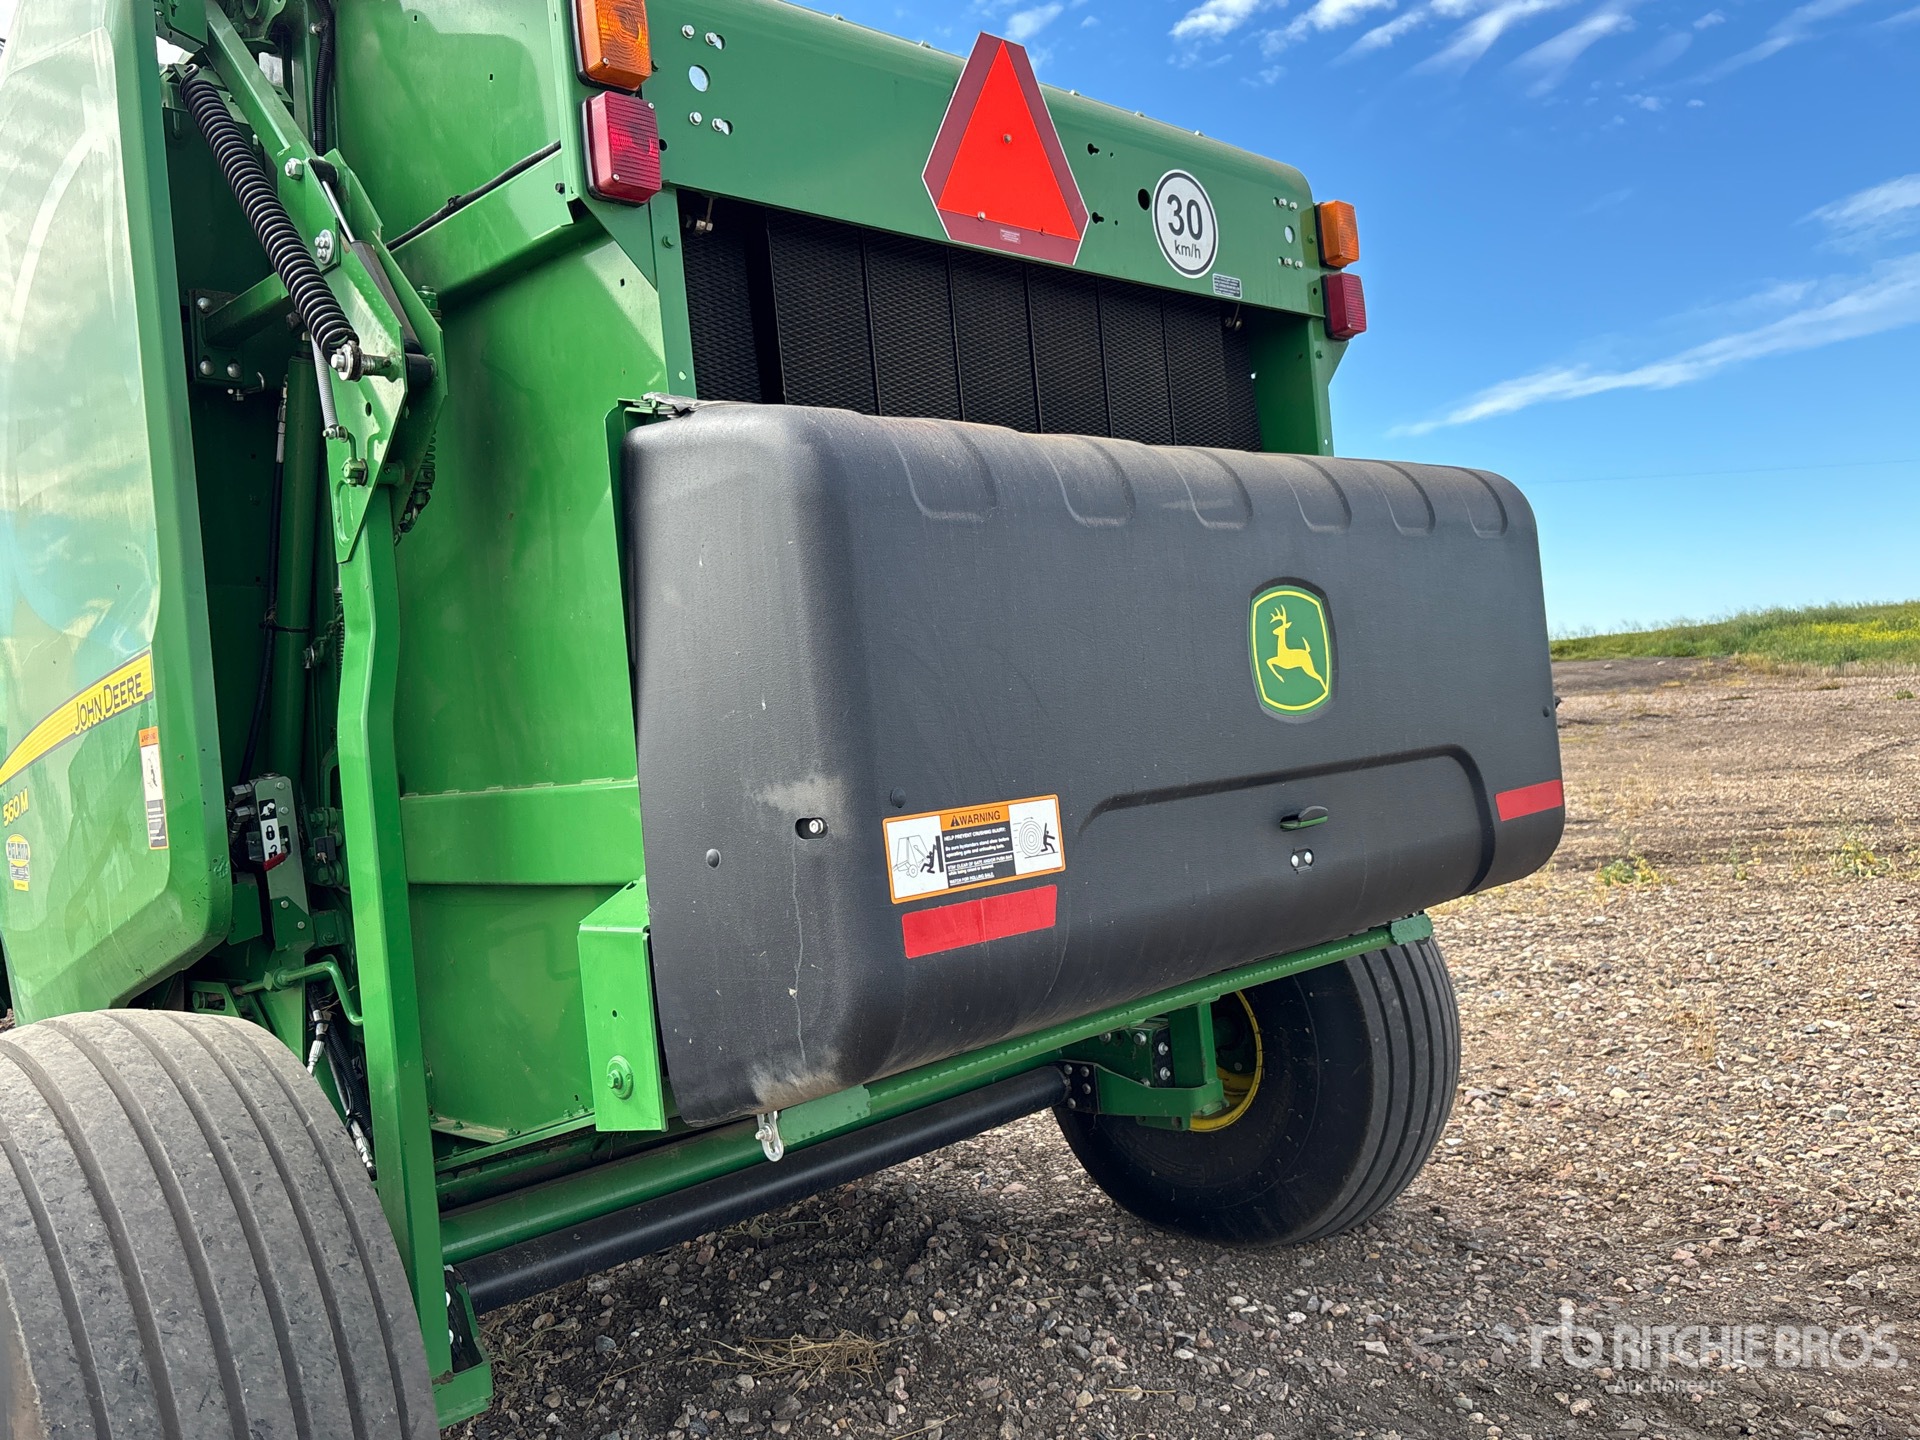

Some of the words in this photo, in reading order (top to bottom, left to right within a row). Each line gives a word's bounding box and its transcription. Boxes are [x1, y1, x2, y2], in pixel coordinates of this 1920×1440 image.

[1167, 194, 1203, 241] 30
[1174, 240, 1201, 260] km/h
[75, 694, 102, 731] JOHN
[103, 672, 143, 714] DEERE
[3, 794, 20, 828] 560
[20, 786, 29, 814] M
[959, 810, 1001, 825] WARNING
